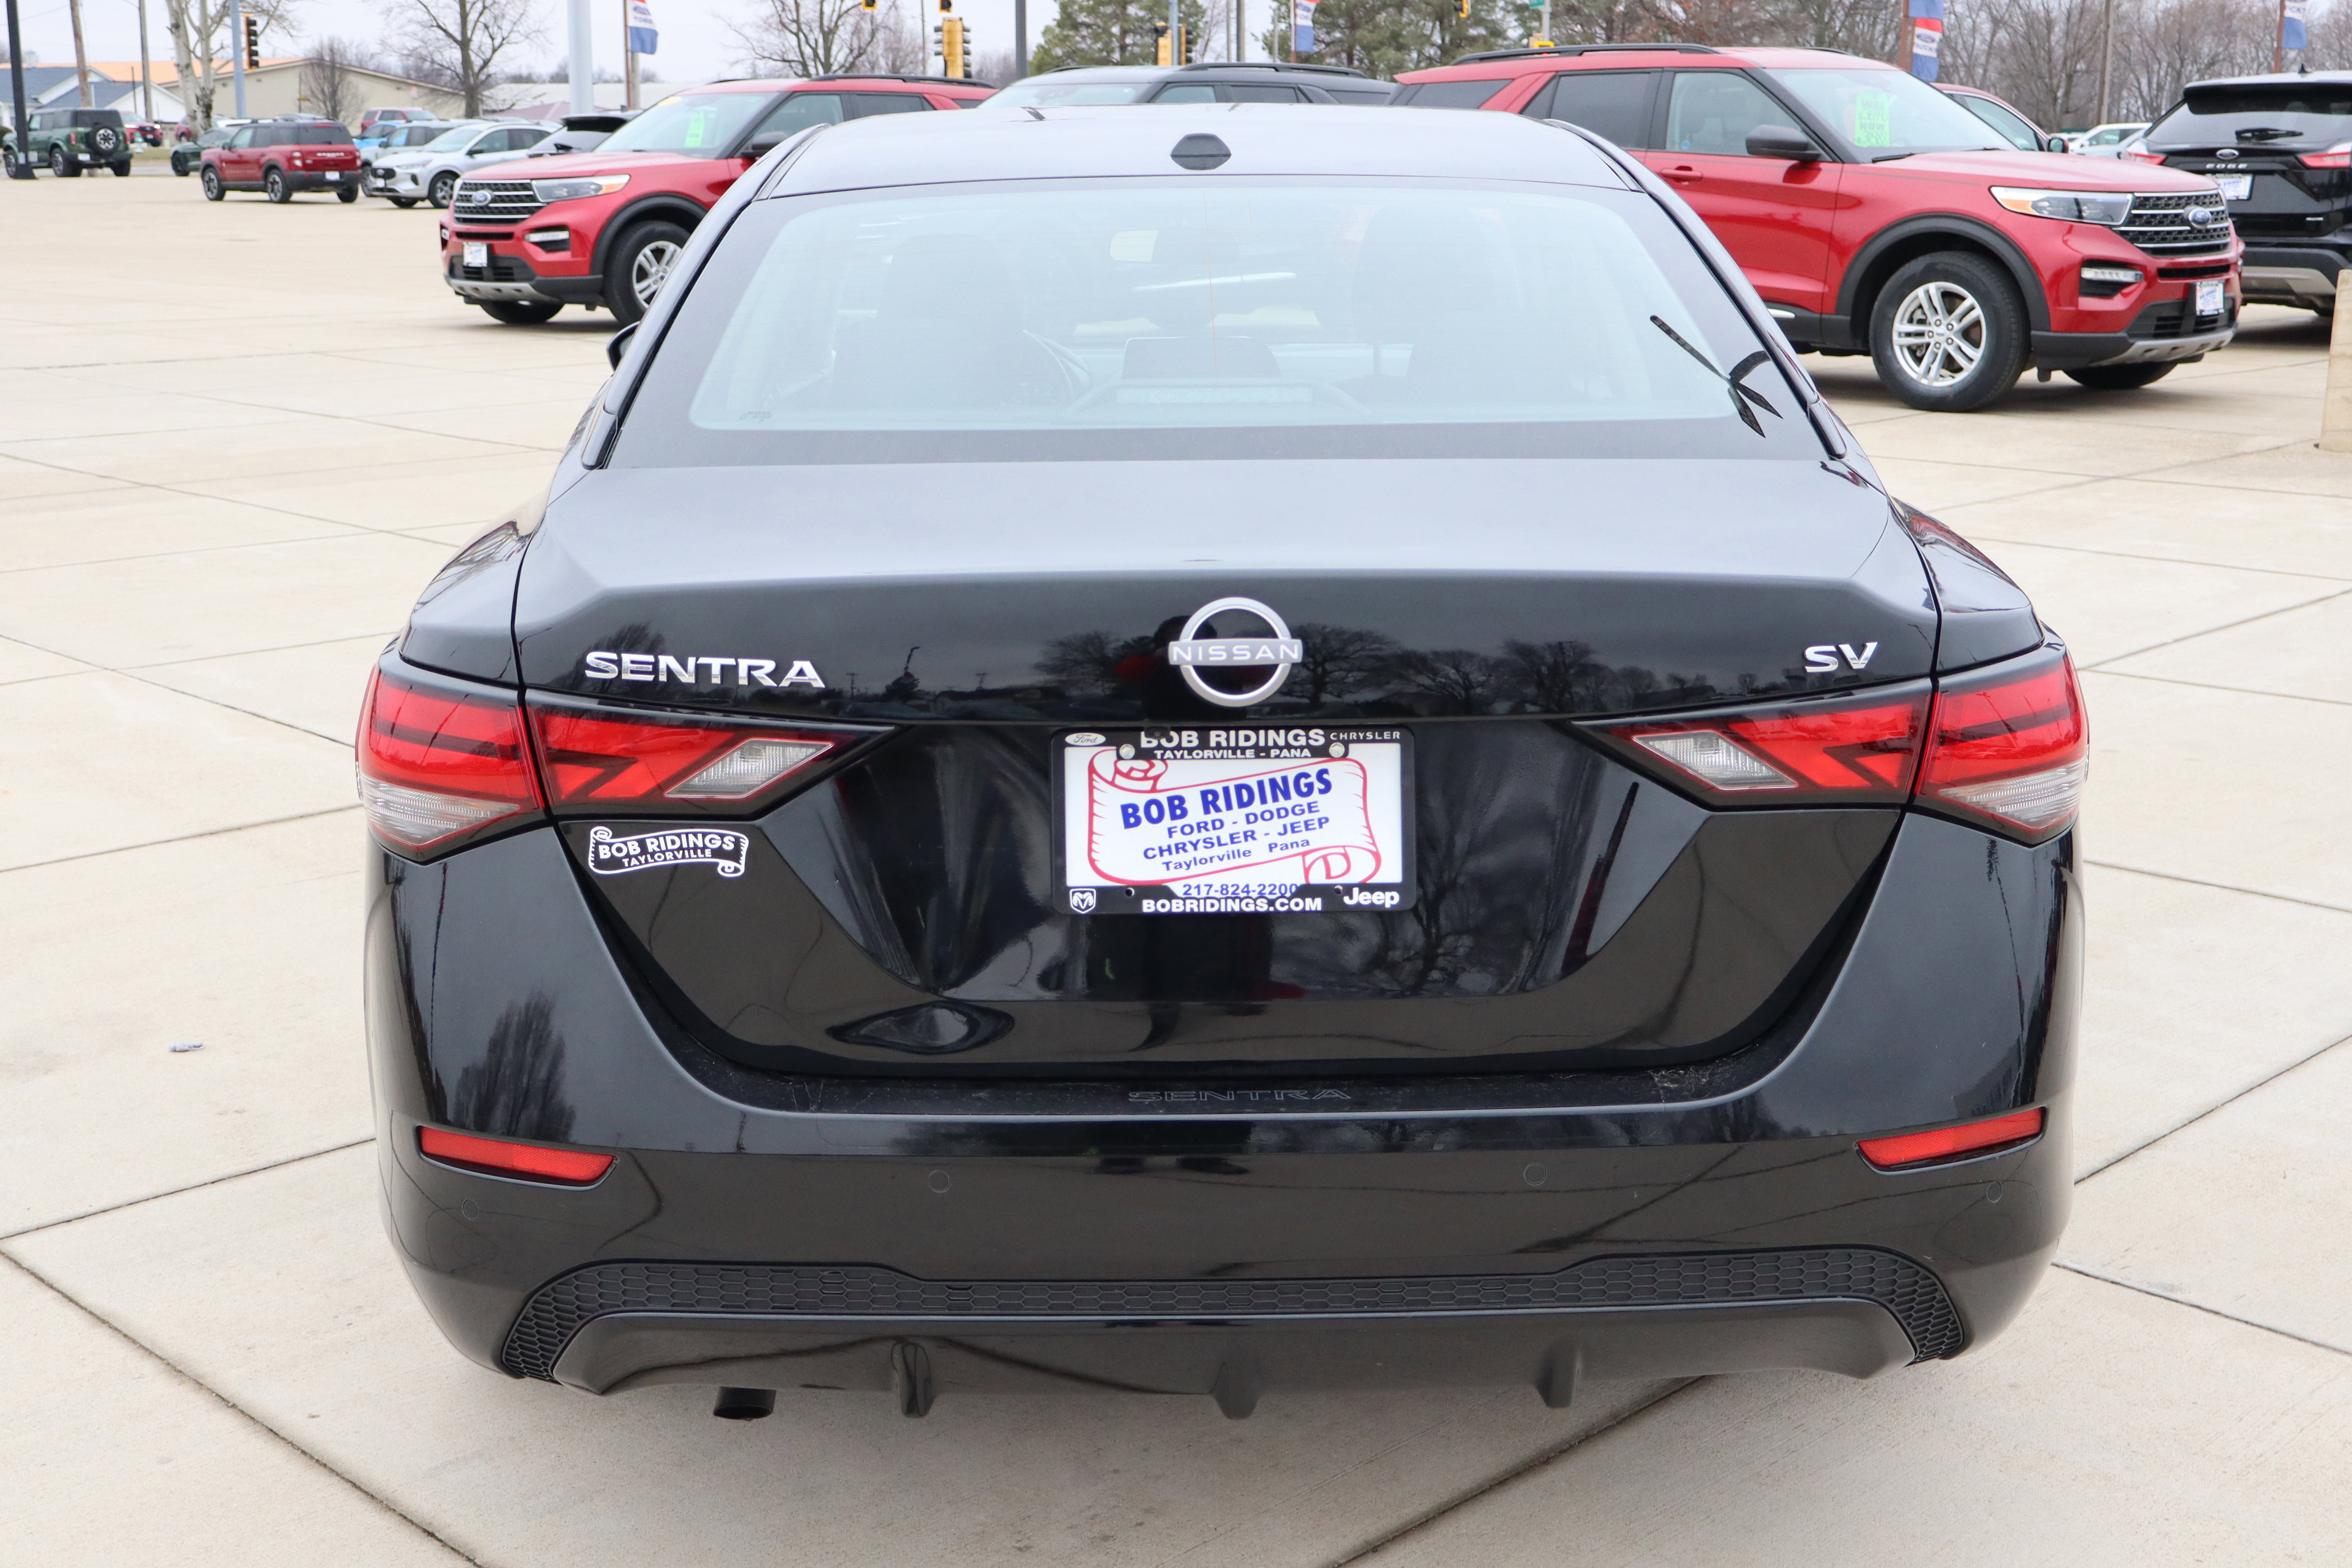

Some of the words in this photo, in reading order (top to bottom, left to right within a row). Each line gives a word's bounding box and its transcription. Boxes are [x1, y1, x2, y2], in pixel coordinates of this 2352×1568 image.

[1173, 644, 1298, 661] NISSAN
[1804, 641, 1878, 673] SV
[585, 651, 826, 688] SENTRA
[1073, 734, 1098, 744] Ford
[1209, 729, 1325, 747] RIDINGS
[1330, 731, 1401, 740] CHRYSLER
[1154, 749, 1255, 759] TAYLORVILLE
[1270, 748, 1312, 758] PANA
[1120, 795, 1189, 830] BOB
[1200, 768, 1332, 815] RIDINGS
[1167, 818, 1225, 839] FORD
[1245, 800, 1320, 825] DODGE
[598, 841, 641, 859] BOB
[645, 833, 735, 853] RIDINGS
[1143, 829, 1258, 860] CHRYSLER
[1277, 816, 1330, 836] JEEP
[622, 849, 712, 867] TAYLORVILLE
[1162, 849, 1252, 871] Taylorville
[1268, 839, 1311, 853] Pana
[1183, 883, 1298, 896] 217-824-2200
[1343, 887, 1400, 908] Jeep
[1142, 898, 1322, 913] BOBRIDINGS.COM
[1128, 1089, 1351, 1102] SENTRA
